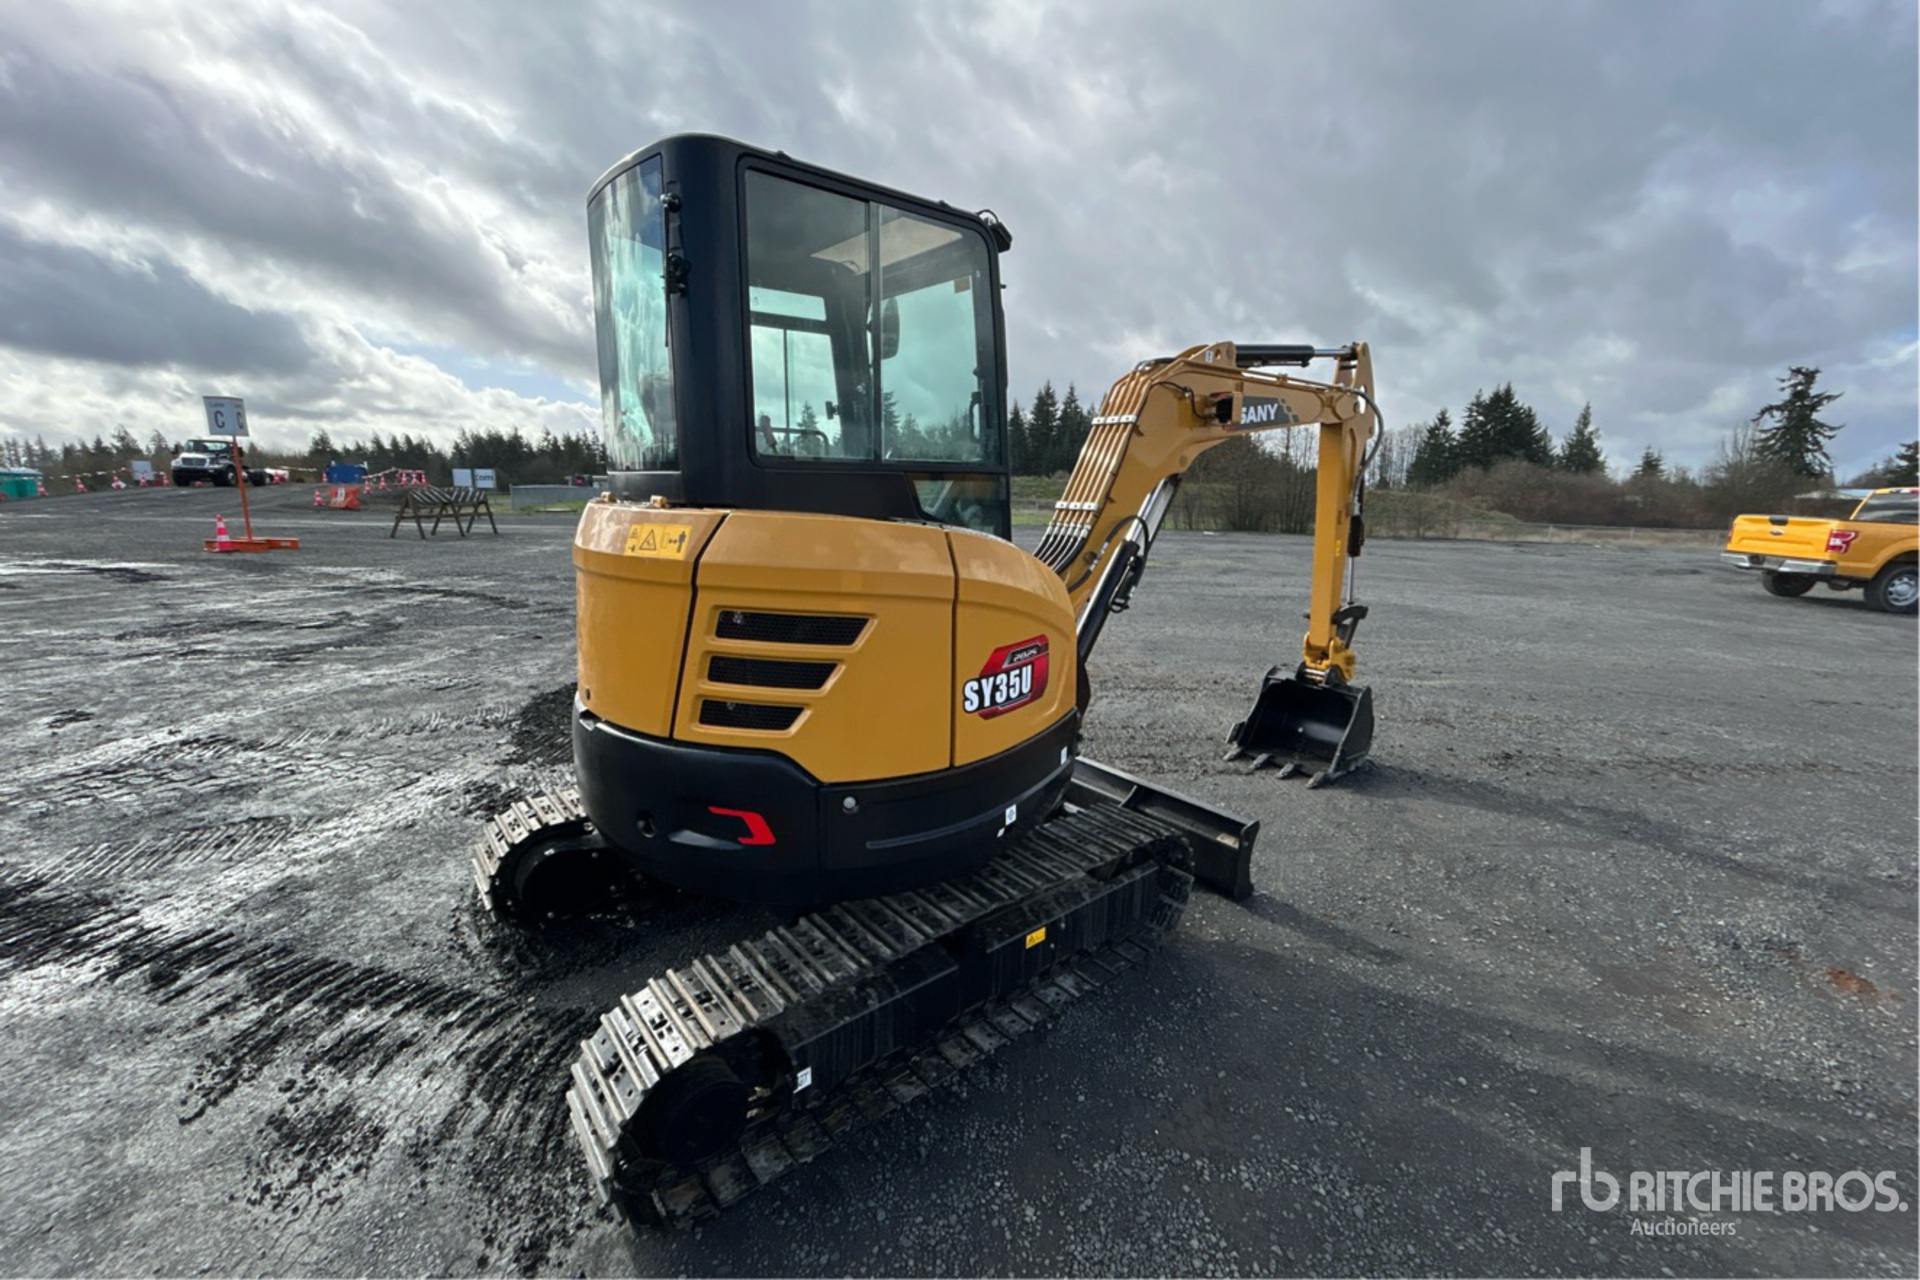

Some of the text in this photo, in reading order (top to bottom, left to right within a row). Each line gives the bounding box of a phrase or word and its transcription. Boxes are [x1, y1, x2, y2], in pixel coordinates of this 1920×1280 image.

[214, 410, 225, 429] C
[236, 411, 244, 429] C
[964, 665, 1033, 711] SY35U
